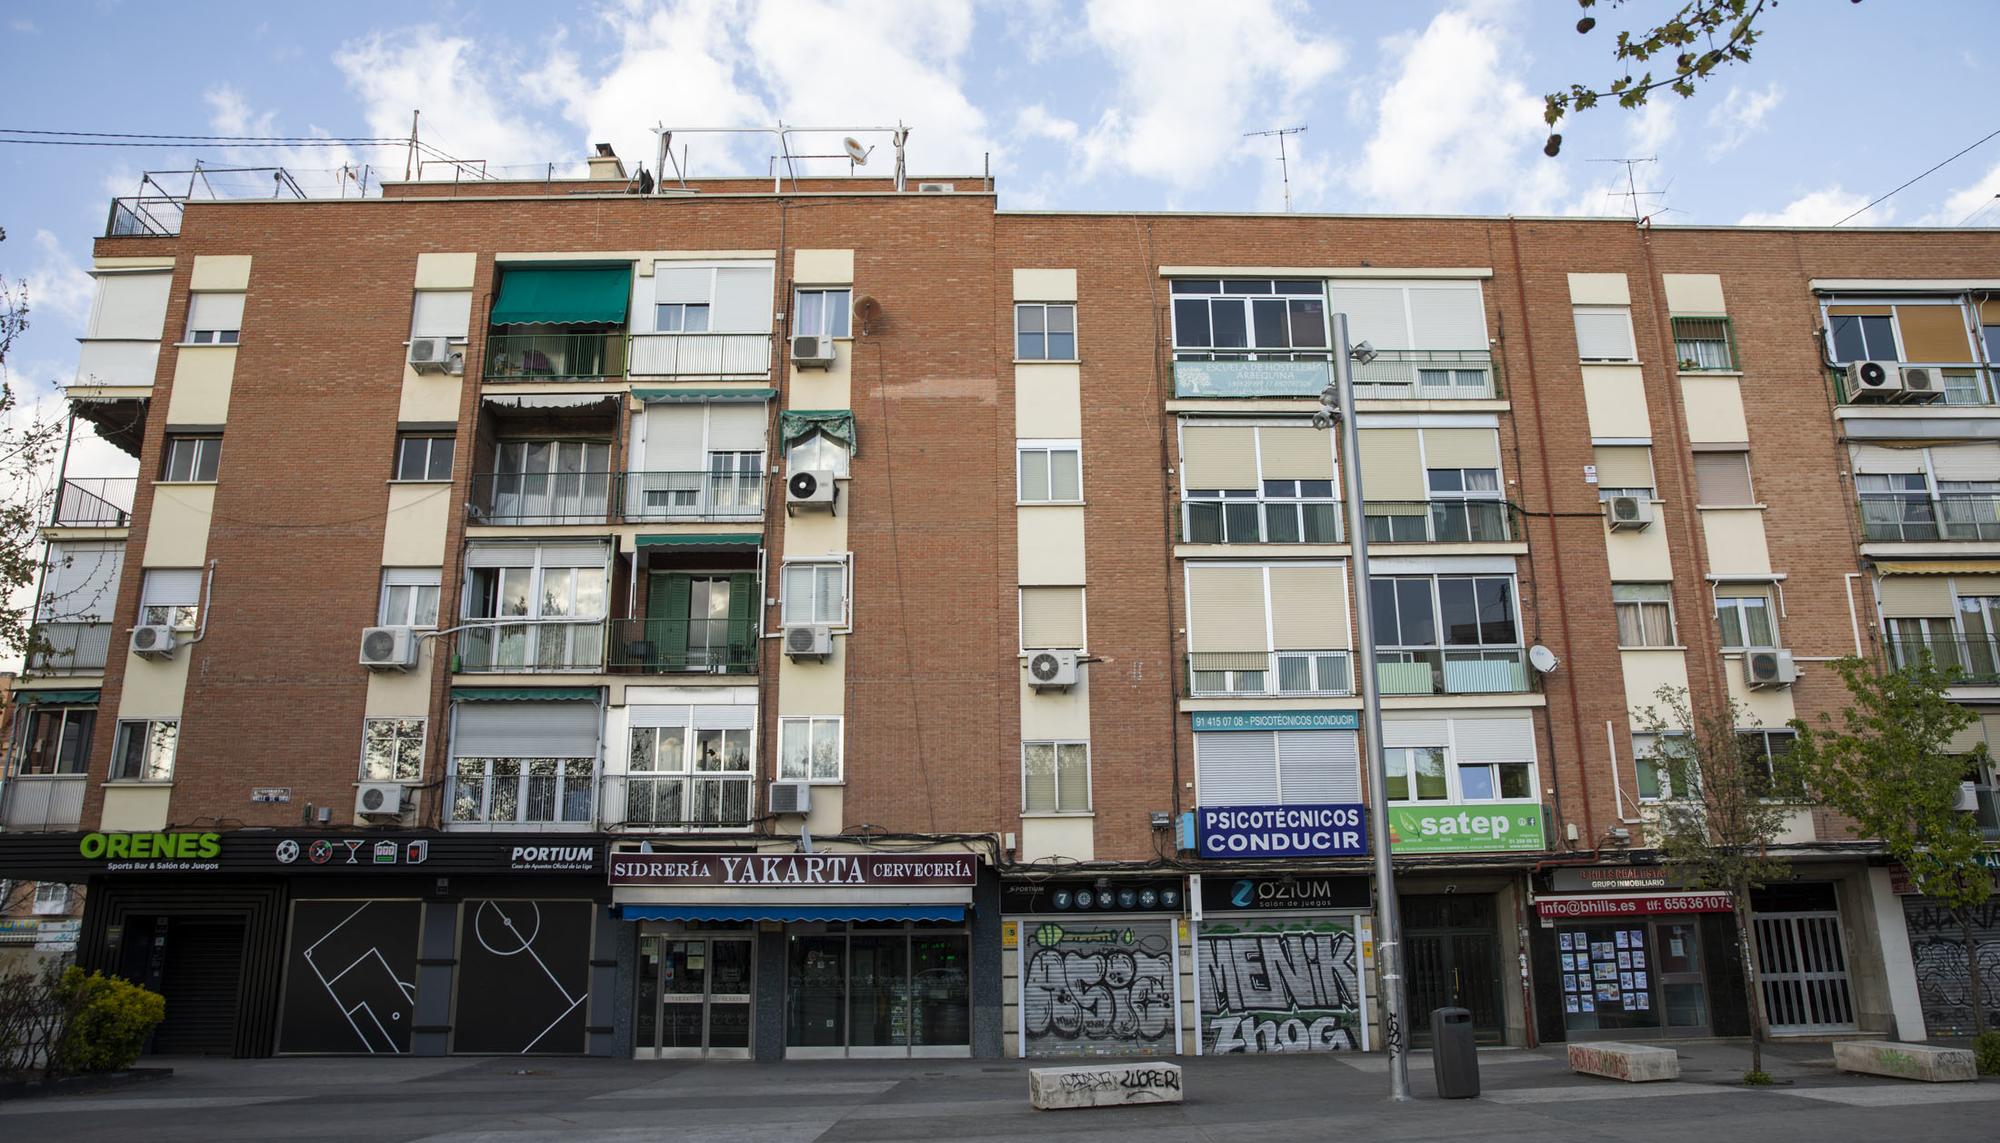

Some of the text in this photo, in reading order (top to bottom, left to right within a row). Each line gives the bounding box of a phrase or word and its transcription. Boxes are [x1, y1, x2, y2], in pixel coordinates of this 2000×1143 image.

[1196, 716, 1204, 726] 91
[1208, 716, 1221, 726] 415
[1222, 716, 1232, 726] 07
[1234, 716, 1242, 726] 08
[1250, 714, 1312, 726] PSICOTÉCNICOS
[1314, 715, 1354, 726] CONDUCIR
[1206, 808, 1359, 830] PSICOTÉCNICOS
[1421, 811, 1509, 839] satep
[80, 832, 222, 859] ORENES
[1206, 831, 1360, 852] CONDUCIR
[512, 847, 593, 861] PORTIUM
[108, 862, 132, 870] Sports
[191, 862, 219, 870] Juegos
[614, 857, 972, 884] SIDRERÍA YAKARTA CERVECERÍA
[1617, 879, 1664, 887] INMOBILIARIO
[1540, 897, 1732, 915] info@bhills.es tlf: 656361075
